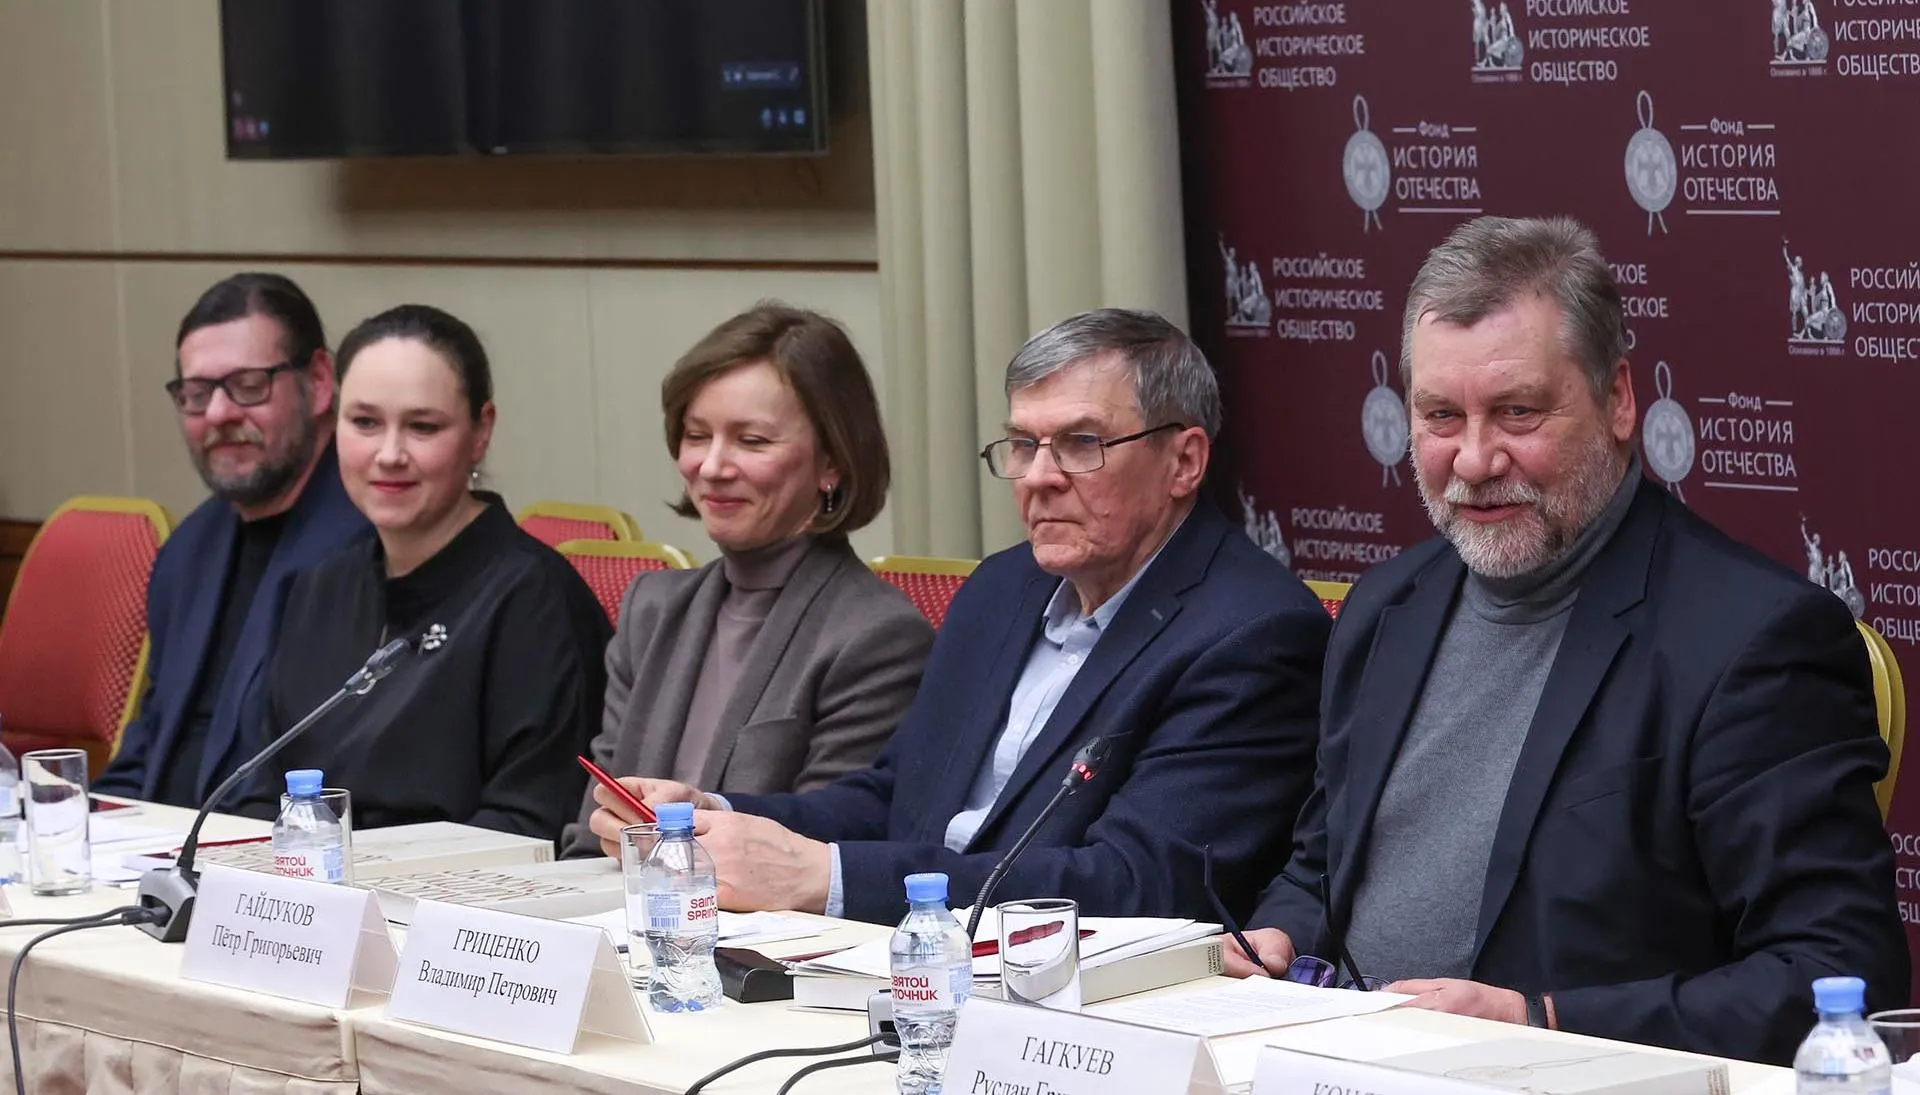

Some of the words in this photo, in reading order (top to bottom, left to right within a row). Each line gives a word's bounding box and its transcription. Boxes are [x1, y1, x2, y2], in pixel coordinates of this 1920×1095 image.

[1253, 0, 1346, 26] РОССИЙСКОЕ
[1256, 35, 1365, 57] ИСТОРИЧЕСКОЕ
[1528, 26, 1650, 49] ИСТОРИЧЕСКОЕ
[1258, 66, 1336, 92] ОБЩЕСТВО
[1530, 60, 1617, 87] ОБЩЕСТВО
[1419, 121, 1449, 138] Фонд
[1710, 117, 1744, 136] Фонд
[1393, 145, 1477, 168] ИСТОРИЯ
[1681, 144, 1775, 168] ИСТОРИЯ
[1395, 177, 1480, 200] ОТЕЧЕСТВА
[1684, 177, 1779, 201] ОТЕЧЕСТВА
[1272, 252, 1365, 279] РОССИЙСКОЕ
[1274, 288, 1384, 310] ИСТОРИЧЕСКОЕ
[1277, 319, 1356, 344] ОБЩЕСТВО
[1855, 336, 1920, 364] ОБЩЕС
[1728, 391, 1762, 412] Фонд
[1700, 417, 1793, 444] ИСТОРИЯ
[1702, 449, 1797, 477] ОТЕЧЕСТВА
[1291, 505, 1384, 534] РОССИЙСКОЕ
[235, 891, 315, 926] ГАЙДУКОВ
[212, 924, 241, 956] Пётр
[243, 930, 323, 965] Григорьевич
[453, 928, 540, 964] ГРИЦЕНКО
[418, 959, 485, 998] Владимир
[487, 972, 557, 1005] Петрович
[1021, 1036, 1115, 1076] ГАГКУЕВ
